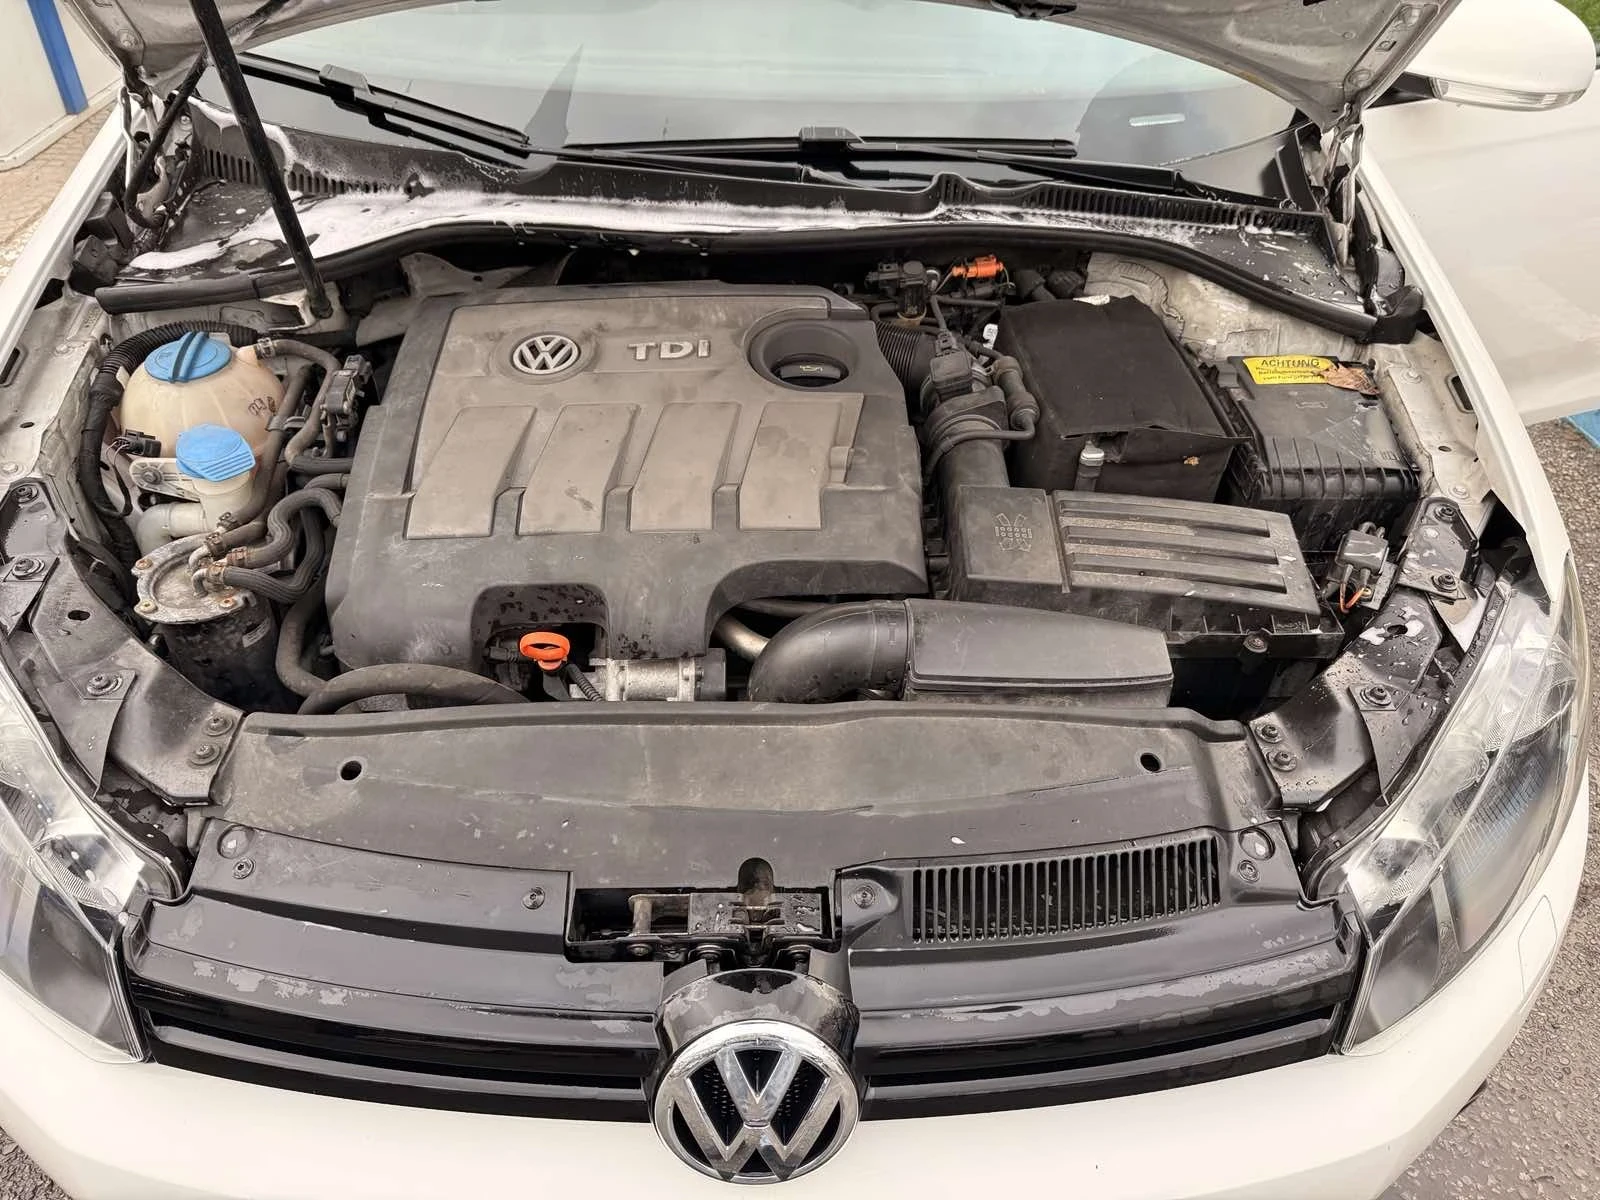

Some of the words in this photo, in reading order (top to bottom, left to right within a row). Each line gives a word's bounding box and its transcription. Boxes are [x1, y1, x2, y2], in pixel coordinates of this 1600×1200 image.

[512, 334, 580, 375] VW
[628, 339, 710, 361] TDI
[1260, 358, 1320, 368] ACHTUNG
[655, 1020, 859, 1184] VW
